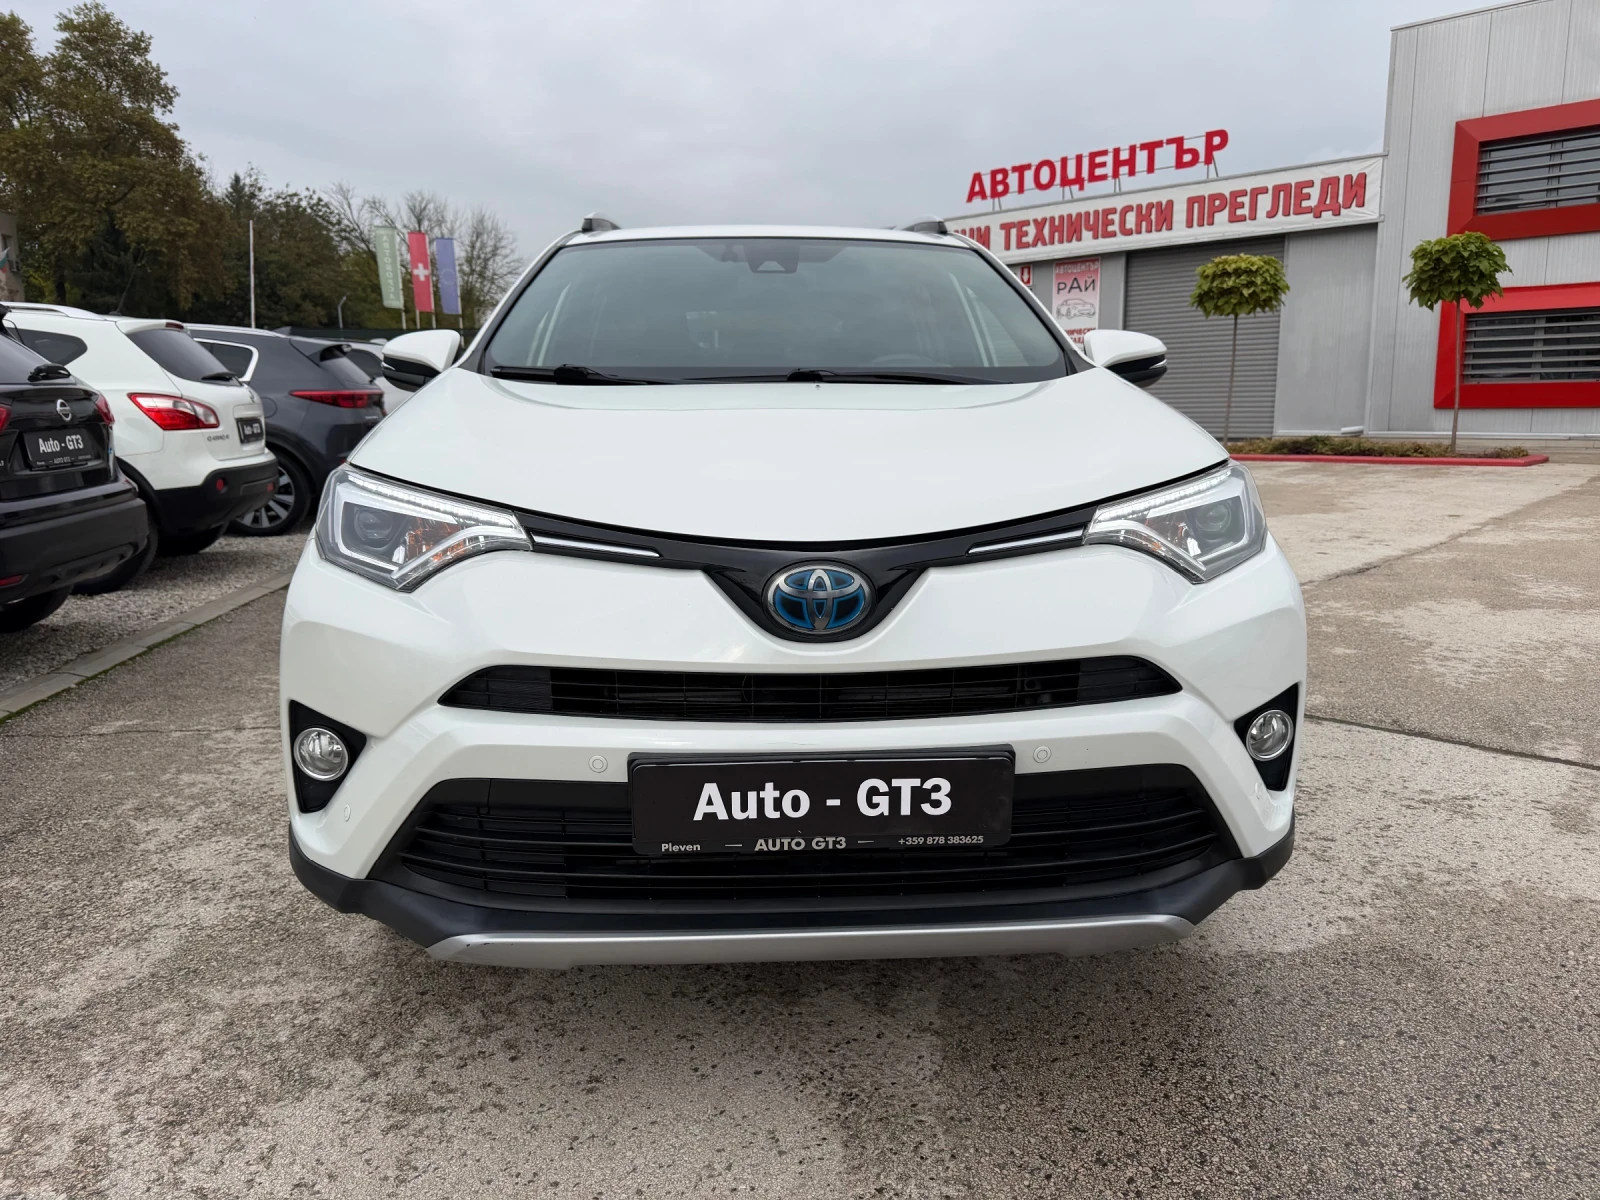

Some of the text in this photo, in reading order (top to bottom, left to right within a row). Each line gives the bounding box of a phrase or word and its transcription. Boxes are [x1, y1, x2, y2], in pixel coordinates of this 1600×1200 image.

[966, 129, 1229, 202] АВТОЦЕНТЪР
[999, 199, 1174, 251] ТЕХНИЧЕСКИ
[1185, 171, 1367, 229] ПРЕГЛЕДИ
[38, 438, 60, 453] Auto
[66, 435, 84, 450] GT3
[693, 782, 810, 821] Auto
[856, 777, 952, 817] GT3
[661, 835, 984, 852] Pleven AUTO GT3 +359 878 383625
